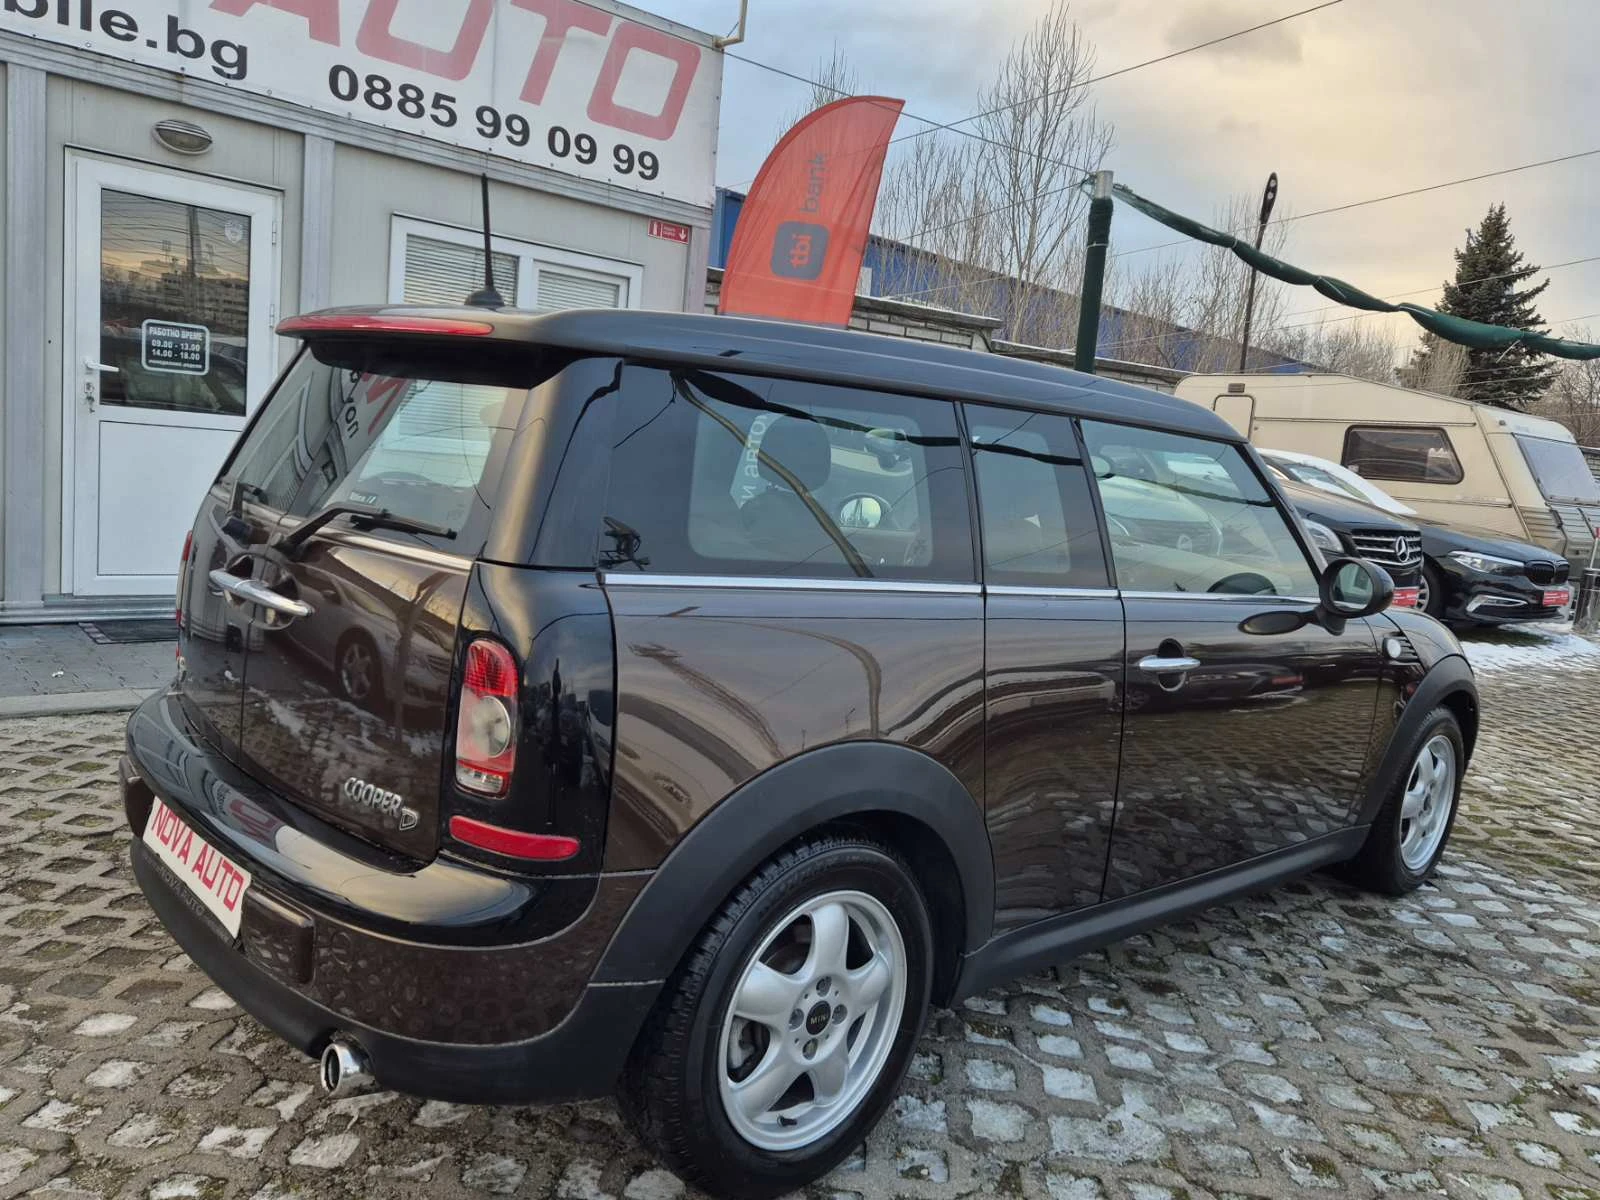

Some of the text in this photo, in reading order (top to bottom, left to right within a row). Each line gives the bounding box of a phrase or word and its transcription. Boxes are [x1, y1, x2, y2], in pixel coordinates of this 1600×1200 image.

[328, 64, 660, 181] 0885 99 09 99
[151, 801, 245, 913] NOVA AUTO
[343, 776, 419, 831] COOPER D
